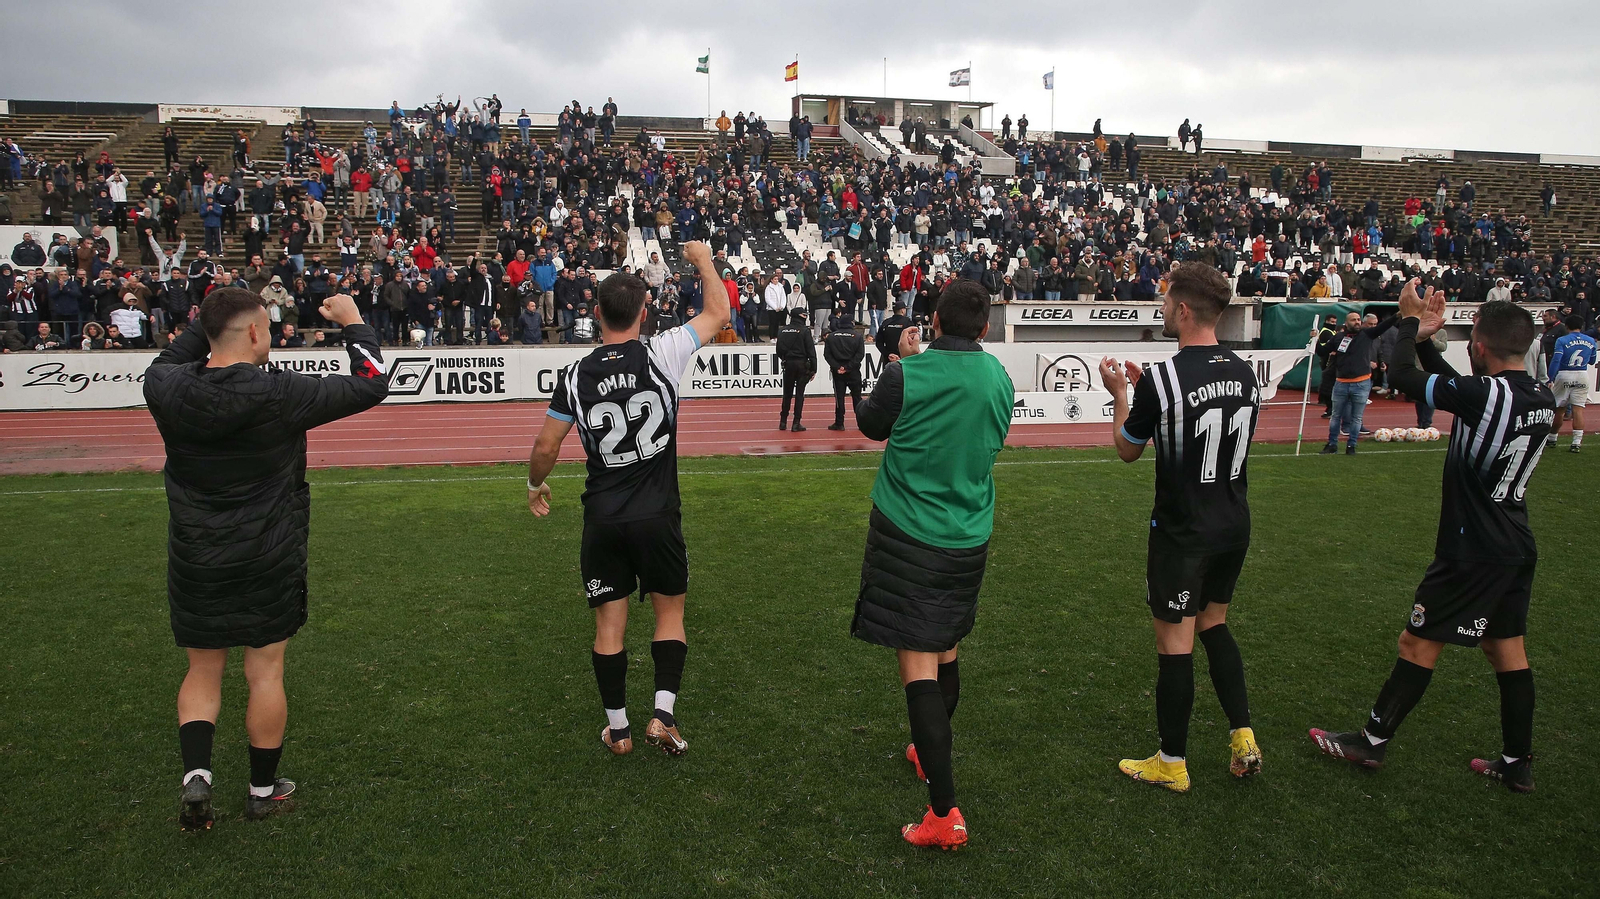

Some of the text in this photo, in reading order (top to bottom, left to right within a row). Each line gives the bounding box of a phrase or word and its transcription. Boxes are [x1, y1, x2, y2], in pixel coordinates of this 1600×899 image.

[1021, 308, 1073, 319] LEGEA
[1089, 309, 1138, 319] LEGEA
[1452, 310, 1477, 319] LEG
[261, 360, 341, 371] INTURAS
[435, 357, 505, 368] INDUSTRIAS
[434, 371, 505, 394] LACSE
[597, 373, 637, 397] OMAR
[692, 379, 783, 389] RESTAURAN
[1187, 380, 1243, 408] CONNOR
[1011, 409, 1047, 417] OTUS.
[587, 390, 670, 468] 22
[1195, 406, 1253, 483] 11
[592, 586, 613, 597] Galán
[1457, 626, 1476, 636] Ruiz
